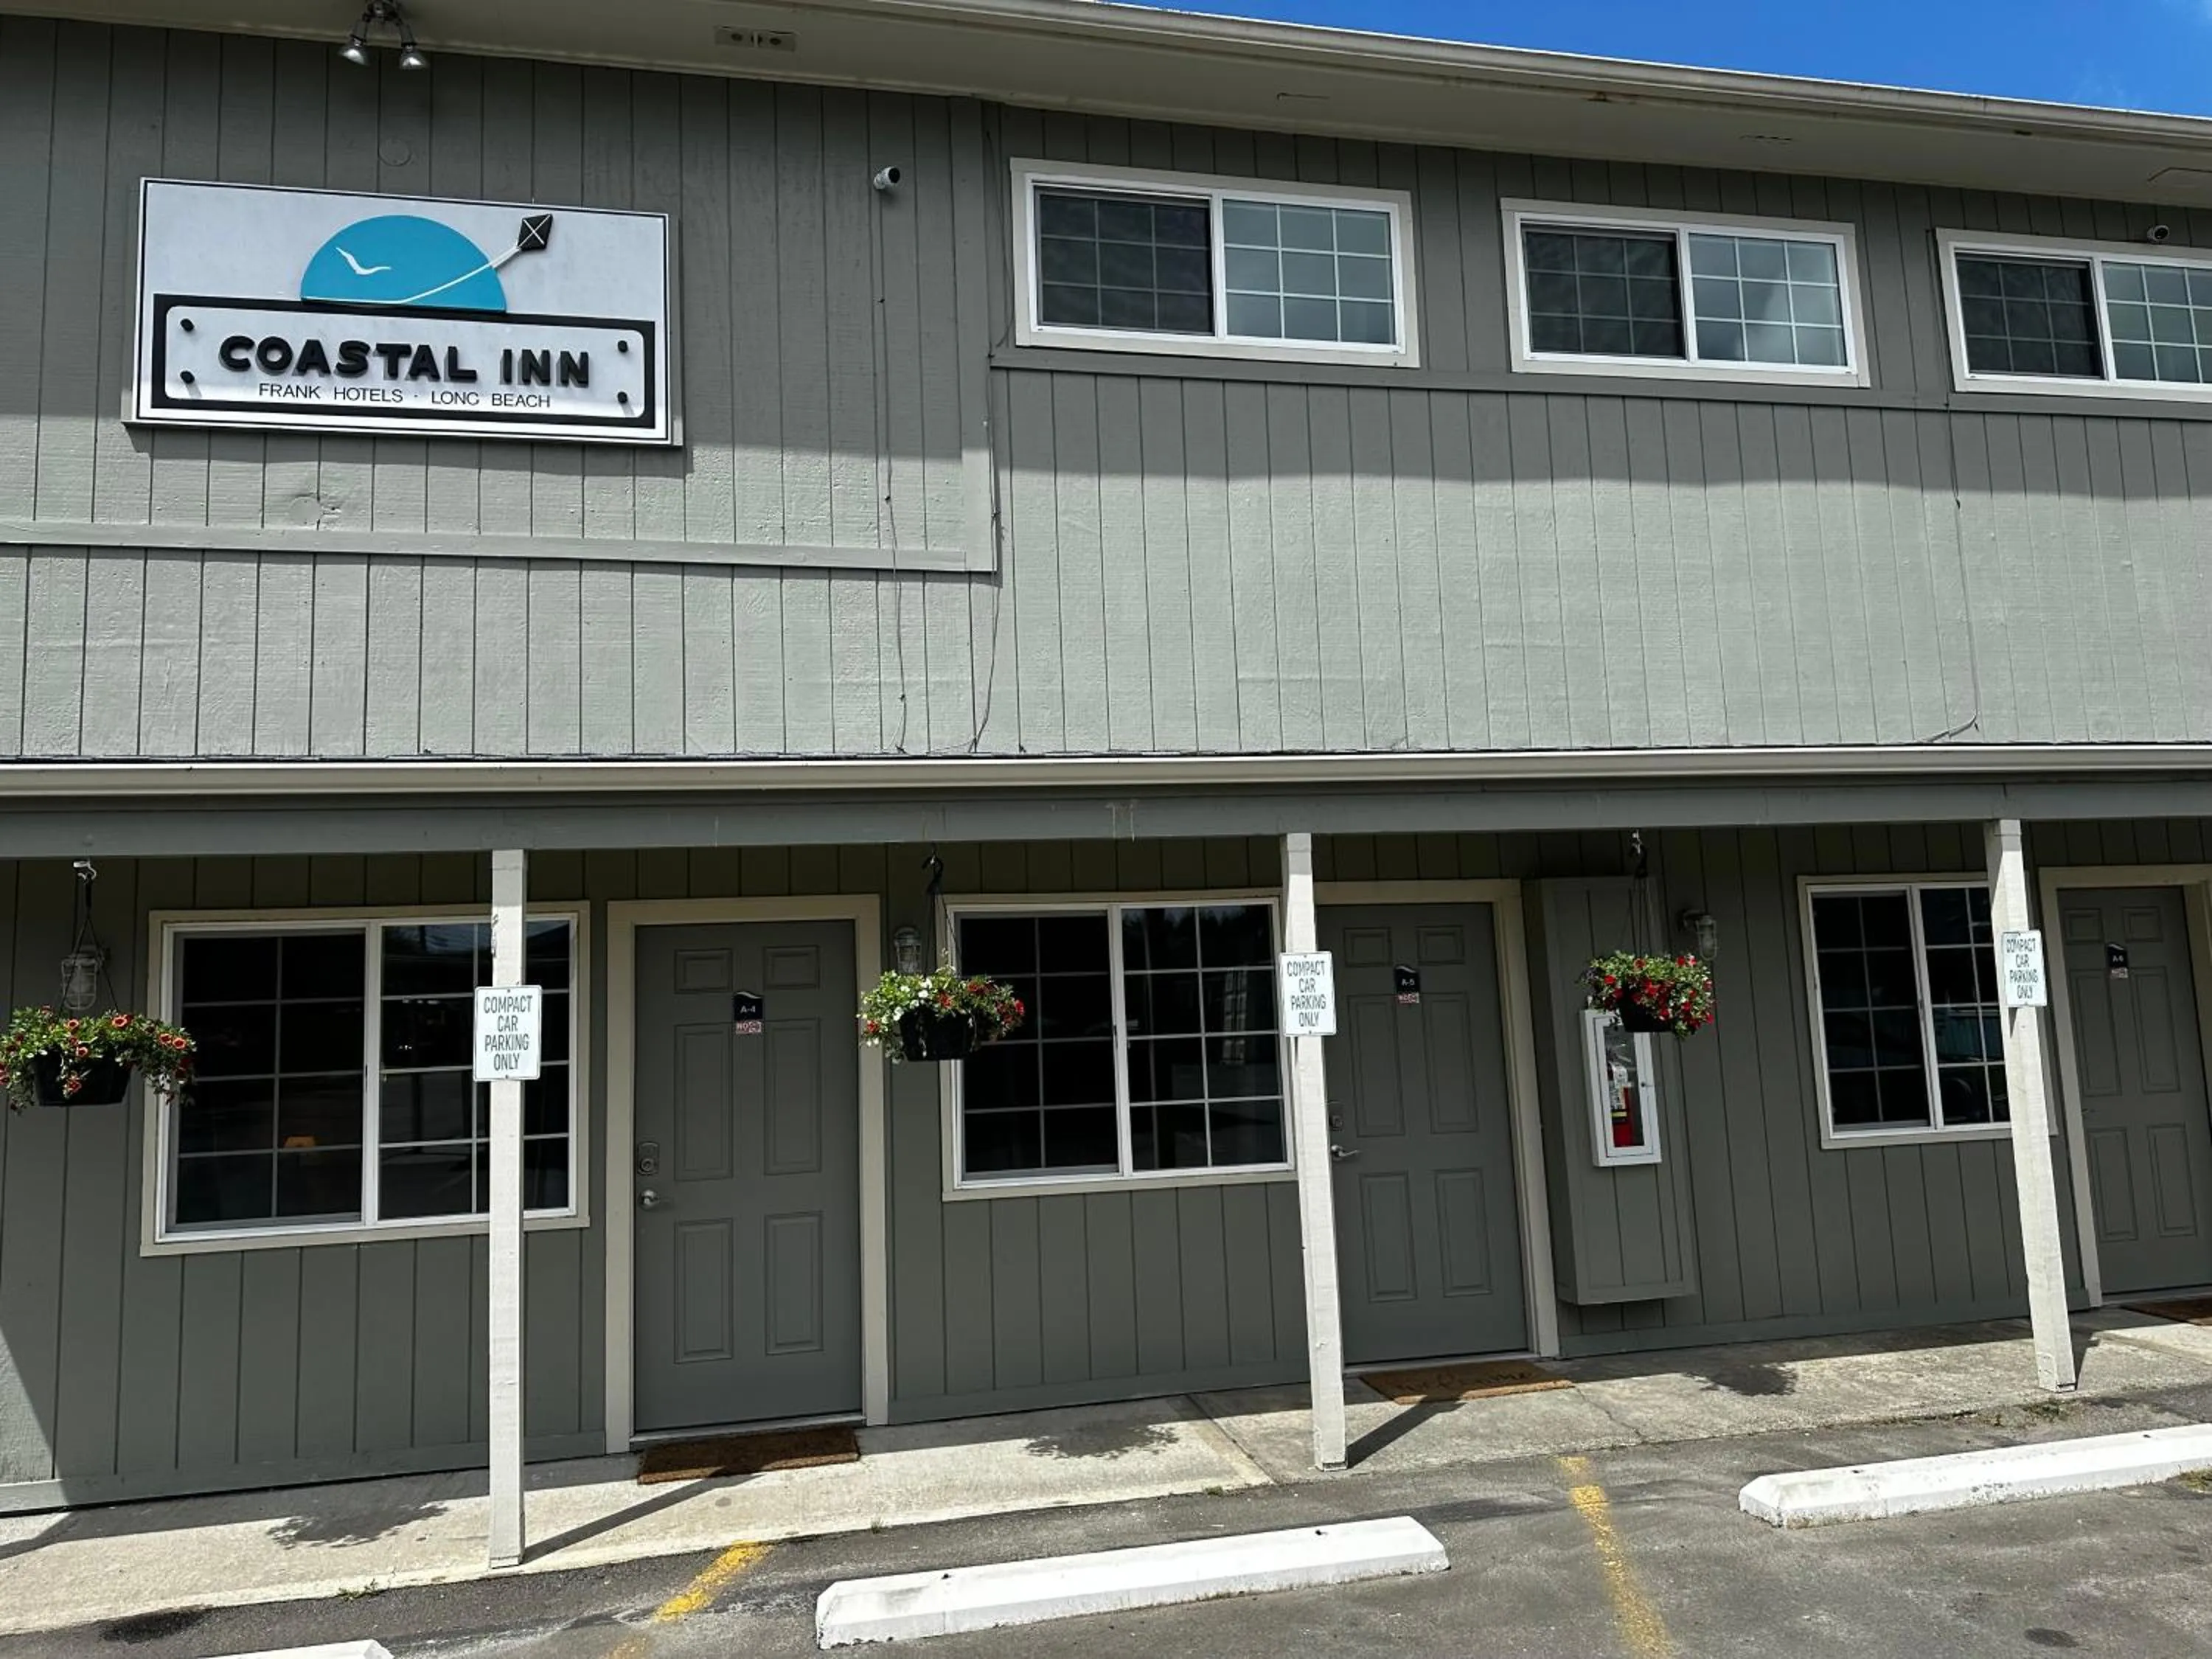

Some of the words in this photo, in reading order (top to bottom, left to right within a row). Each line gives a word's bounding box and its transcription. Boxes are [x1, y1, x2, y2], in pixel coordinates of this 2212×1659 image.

[219, 335, 478, 382] COASTAL
[502, 349, 588, 387] INN
[259, 383, 321, 399] FRANK
[334, 386, 403, 403] HOTELS
[431, 391, 479, 406] LONG
[492, 393, 551, 408] BEACH
[2006, 938, 2036, 953] COMPACT
[1287, 960, 1326, 977] COMPACT
[2016, 954, 2030, 968] CAR
[2010, 969, 2039, 983] PARKING
[1298, 978, 1315, 993] CAR
[2017, 985, 2033, 999] ONLY
[484, 995, 532, 1014] COMPACT
[740, 1005, 756, 1013] A-4
[1291, 994, 1326, 1011] PARKING
[497, 1015, 518, 1032] CAR
[1298, 1012, 1320, 1027] ONLY
[484, 1033, 529, 1051] PARKING
[493, 1053, 519, 1071] ONLY
